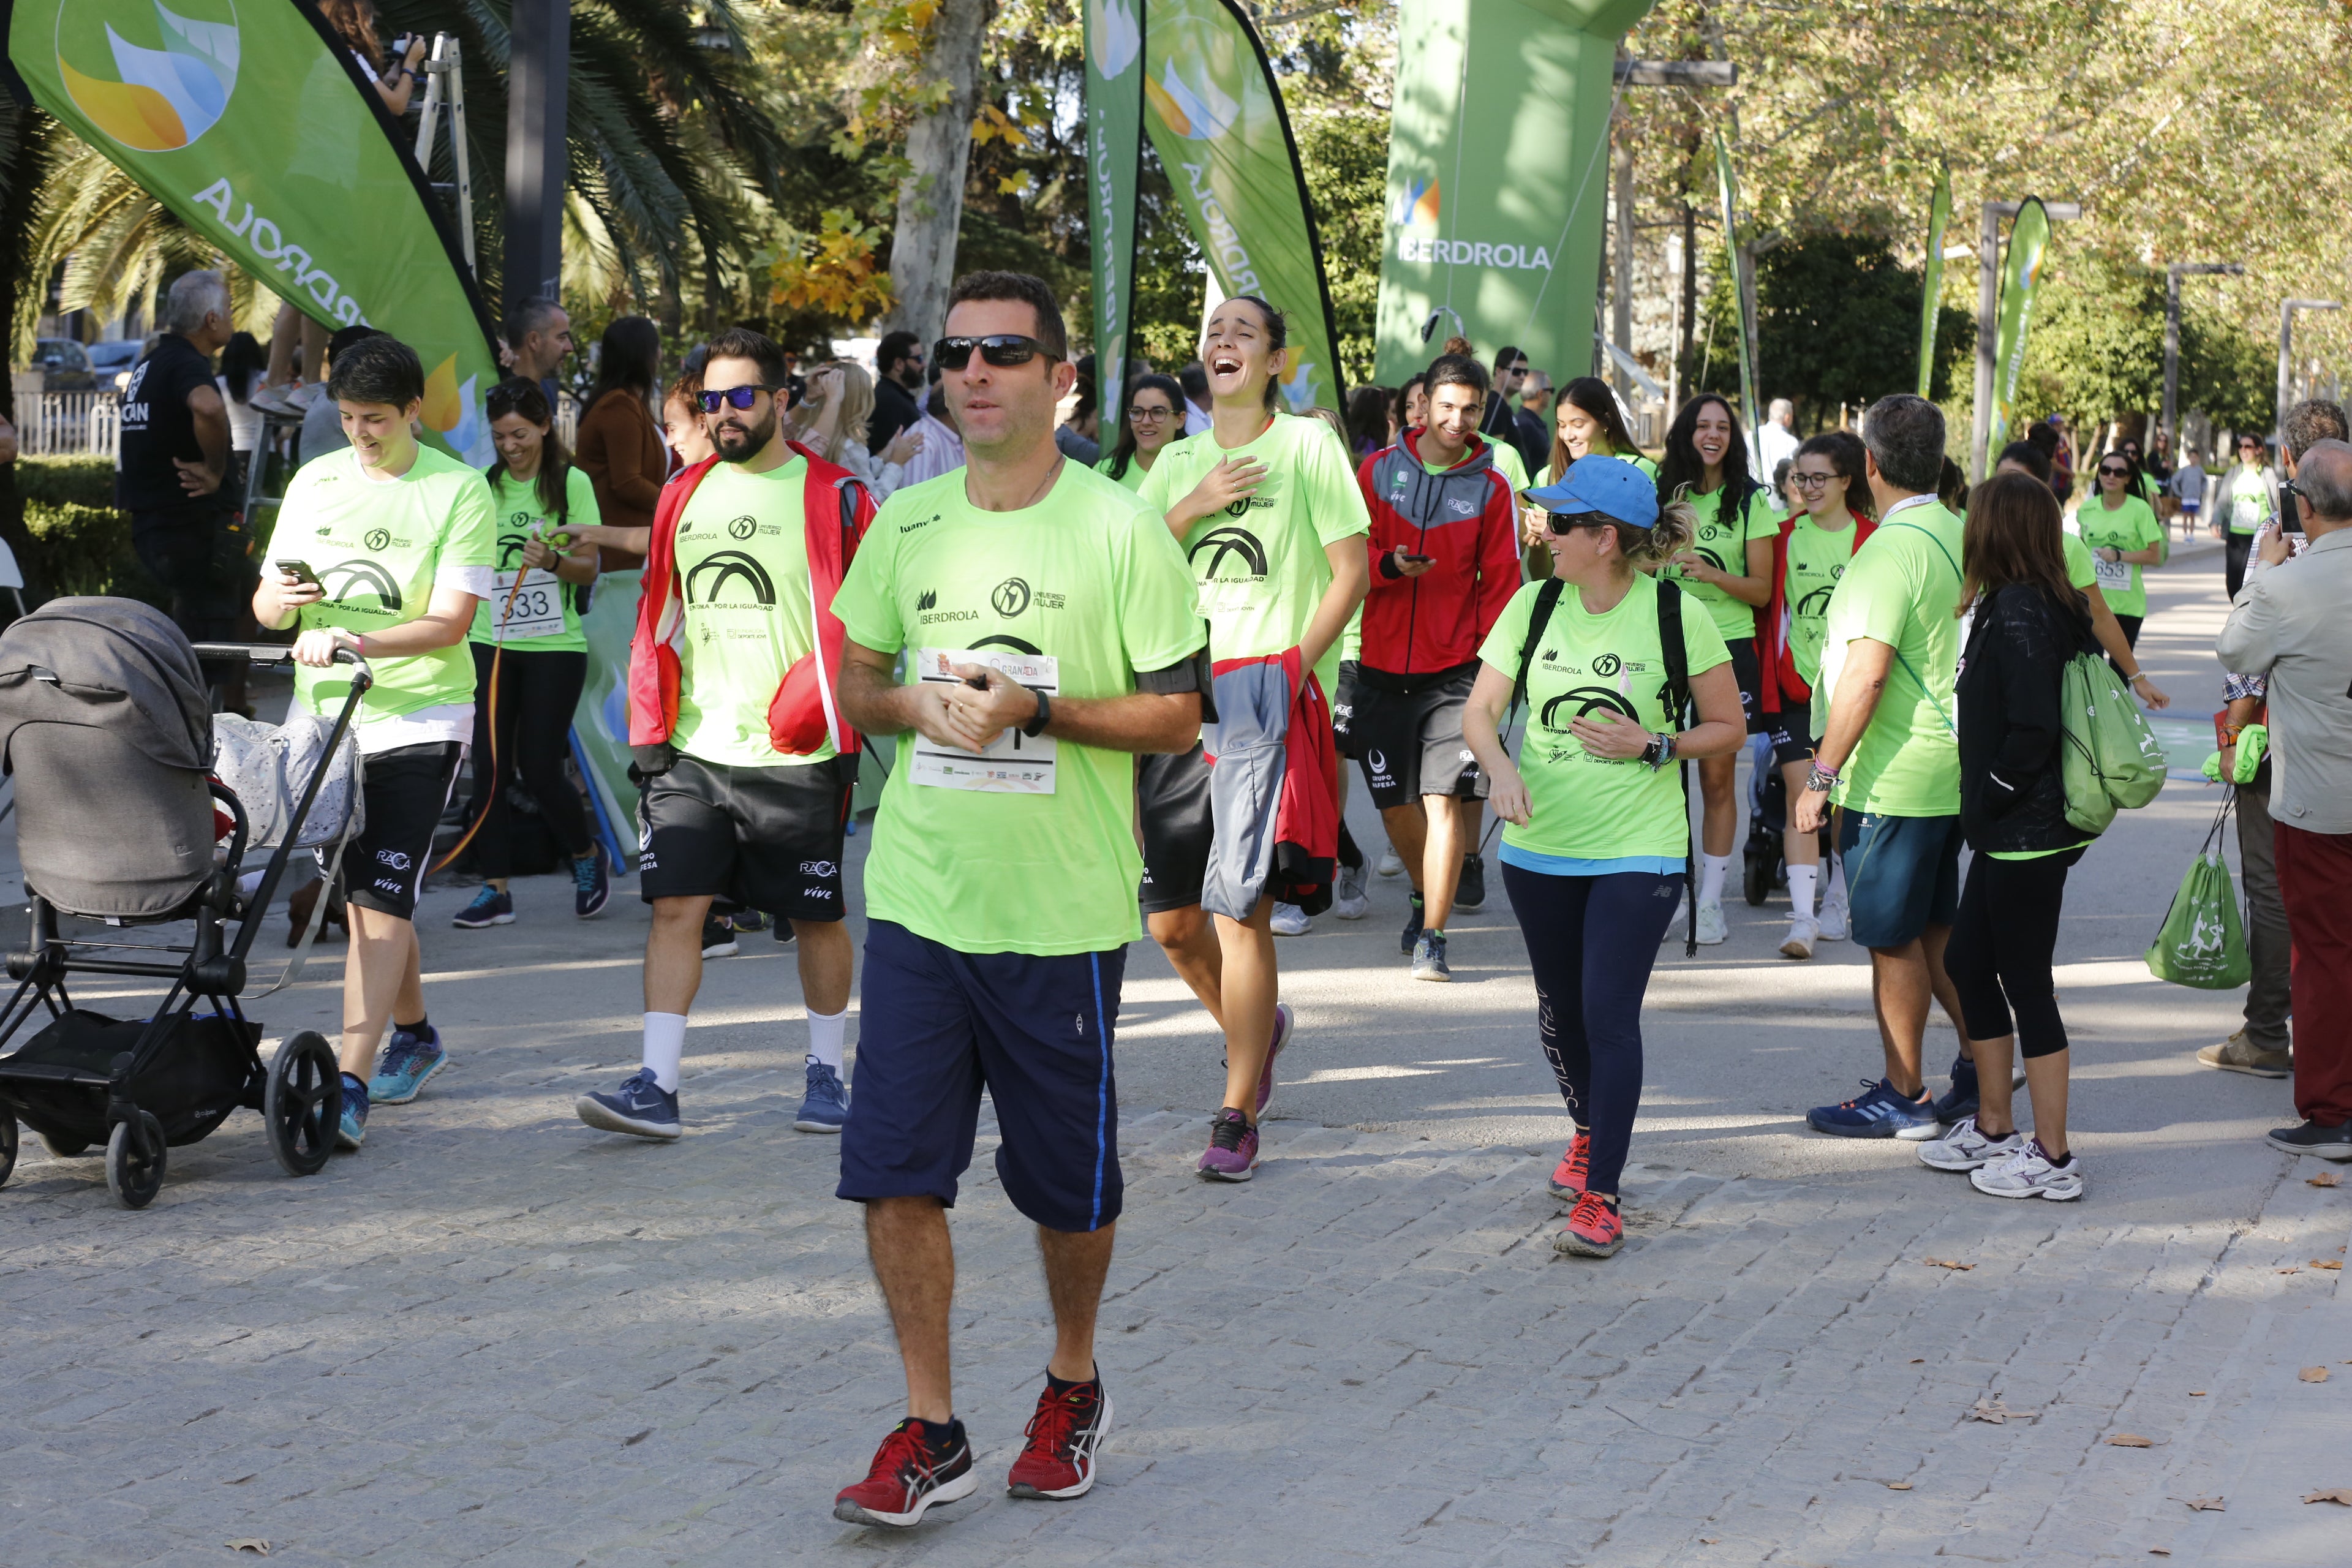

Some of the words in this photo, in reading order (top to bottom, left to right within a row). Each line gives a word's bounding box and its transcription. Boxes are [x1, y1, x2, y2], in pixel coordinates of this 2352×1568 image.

[1398, 236, 1553, 271] IBERDROLA
[679, 533, 718, 543] IBERDROLA
[2095, 560, 2125, 578] 653
[499, 590, 550, 620] 333
[920, 610, 979, 625] IBERDROLA
[1001, 665, 1038, 677] GRANADA
[1542, 663, 1582, 675] IBERDROLA
[1335, 704, 1354, 718] RAC
[376, 850, 411, 870] RACA
[799, 861, 837, 878] RACA
